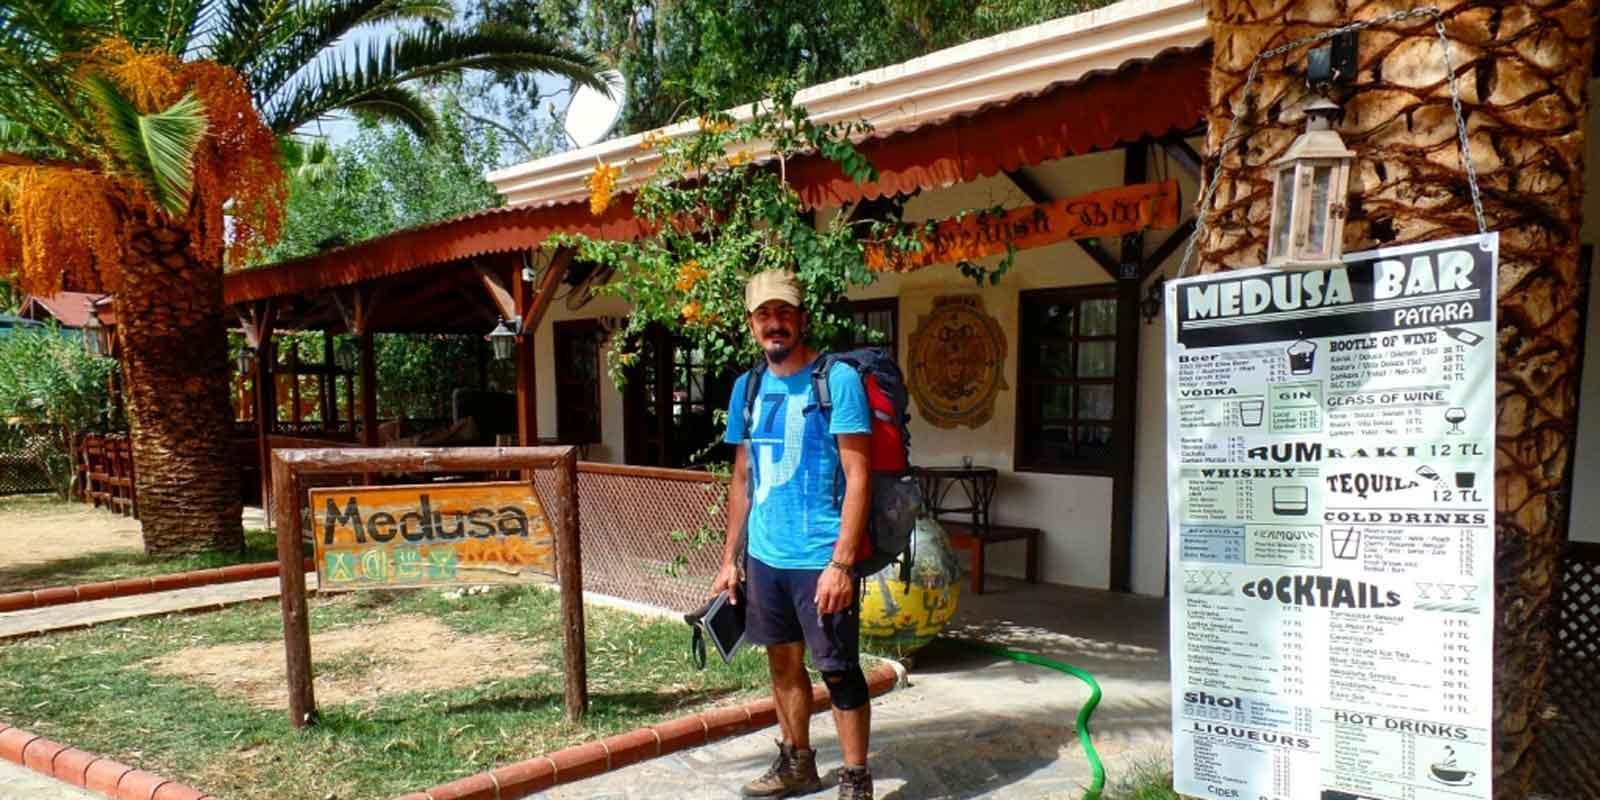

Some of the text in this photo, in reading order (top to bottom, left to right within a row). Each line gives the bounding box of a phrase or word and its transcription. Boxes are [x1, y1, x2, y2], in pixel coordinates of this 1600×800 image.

[1186, 250, 1475, 320] MEDUSA BAR
[1393, 302, 1473, 327] PATARA
[1329, 331, 1437, 352] BOOTLE OF WINE
[1178, 354, 1219, 363] Beer
[1181, 387, 1238, 397] VODKA
[1279, 391, 1312, 401] GIN
[1327, 391, 1445, 407] GLASS OF WINE
[1248, 442, 1322, 463] RUM
[1326, 443, 1483, 458] RAKI 12 TL
[1201, 468, 1296, 478] WHISKEY
[1326, 472, 1419, 499] TEQUILA
[1433, 490, 1482, 502] 12 TL
[324, 493, 529, 545] Medusa
[1324, 511, 1486, 524] COLD DRINKS
[1242, 575, 1401, 608] COCKTAILS
[1334, 711, 1376, 726] HOT
[1385, 718, 1468, 740] DRINKS
[1193, 722, 1310, 749] LIQUEURS
[1207, 784, 1240, 798] CIDER
